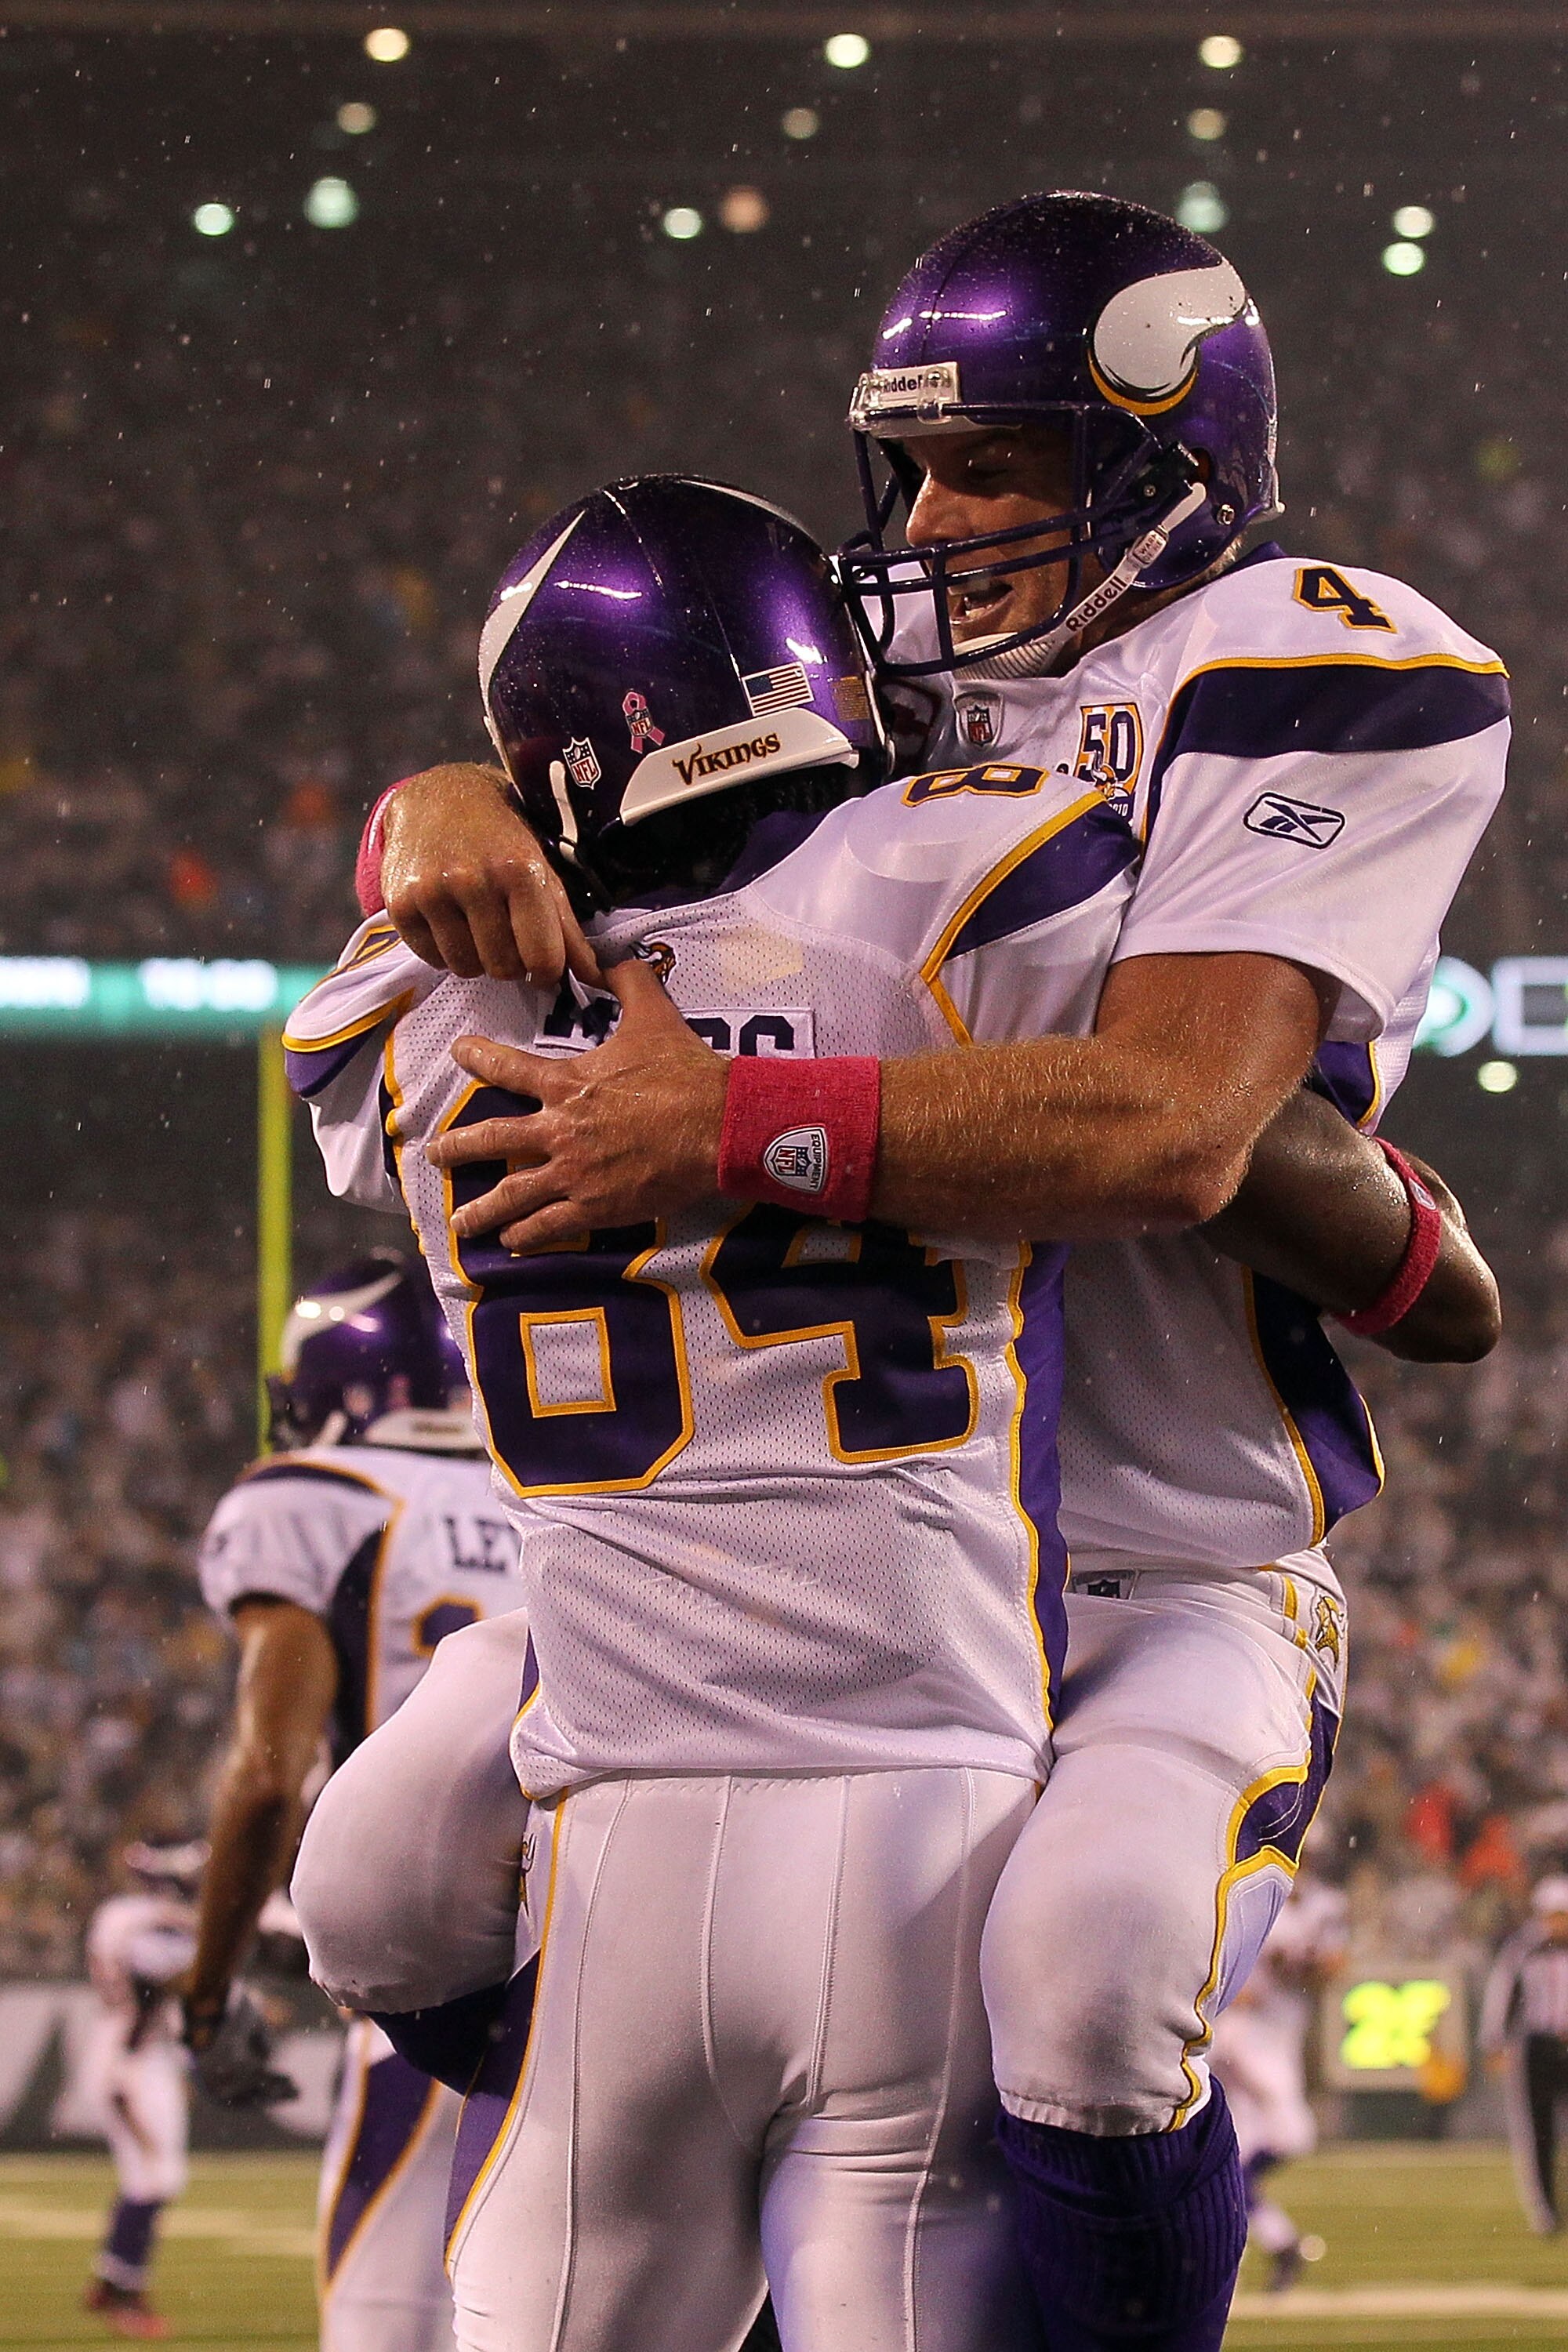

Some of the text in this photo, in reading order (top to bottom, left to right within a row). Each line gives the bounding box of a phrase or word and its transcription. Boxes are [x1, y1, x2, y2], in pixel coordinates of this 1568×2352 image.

[1066, 575, 1127, 632] Riddell
[1292, 565, 1399, 634] 4
[630, 717, 652, 735] NFL
[1077, 710, 1137, 785] 50
[571, 757, 597, 783] NFL
[672, 733, 781, 786] VIKINGS
[775, 1147, 796, 1174] NFL
[810, 1134, 822, 1190] EQUIPMENT
